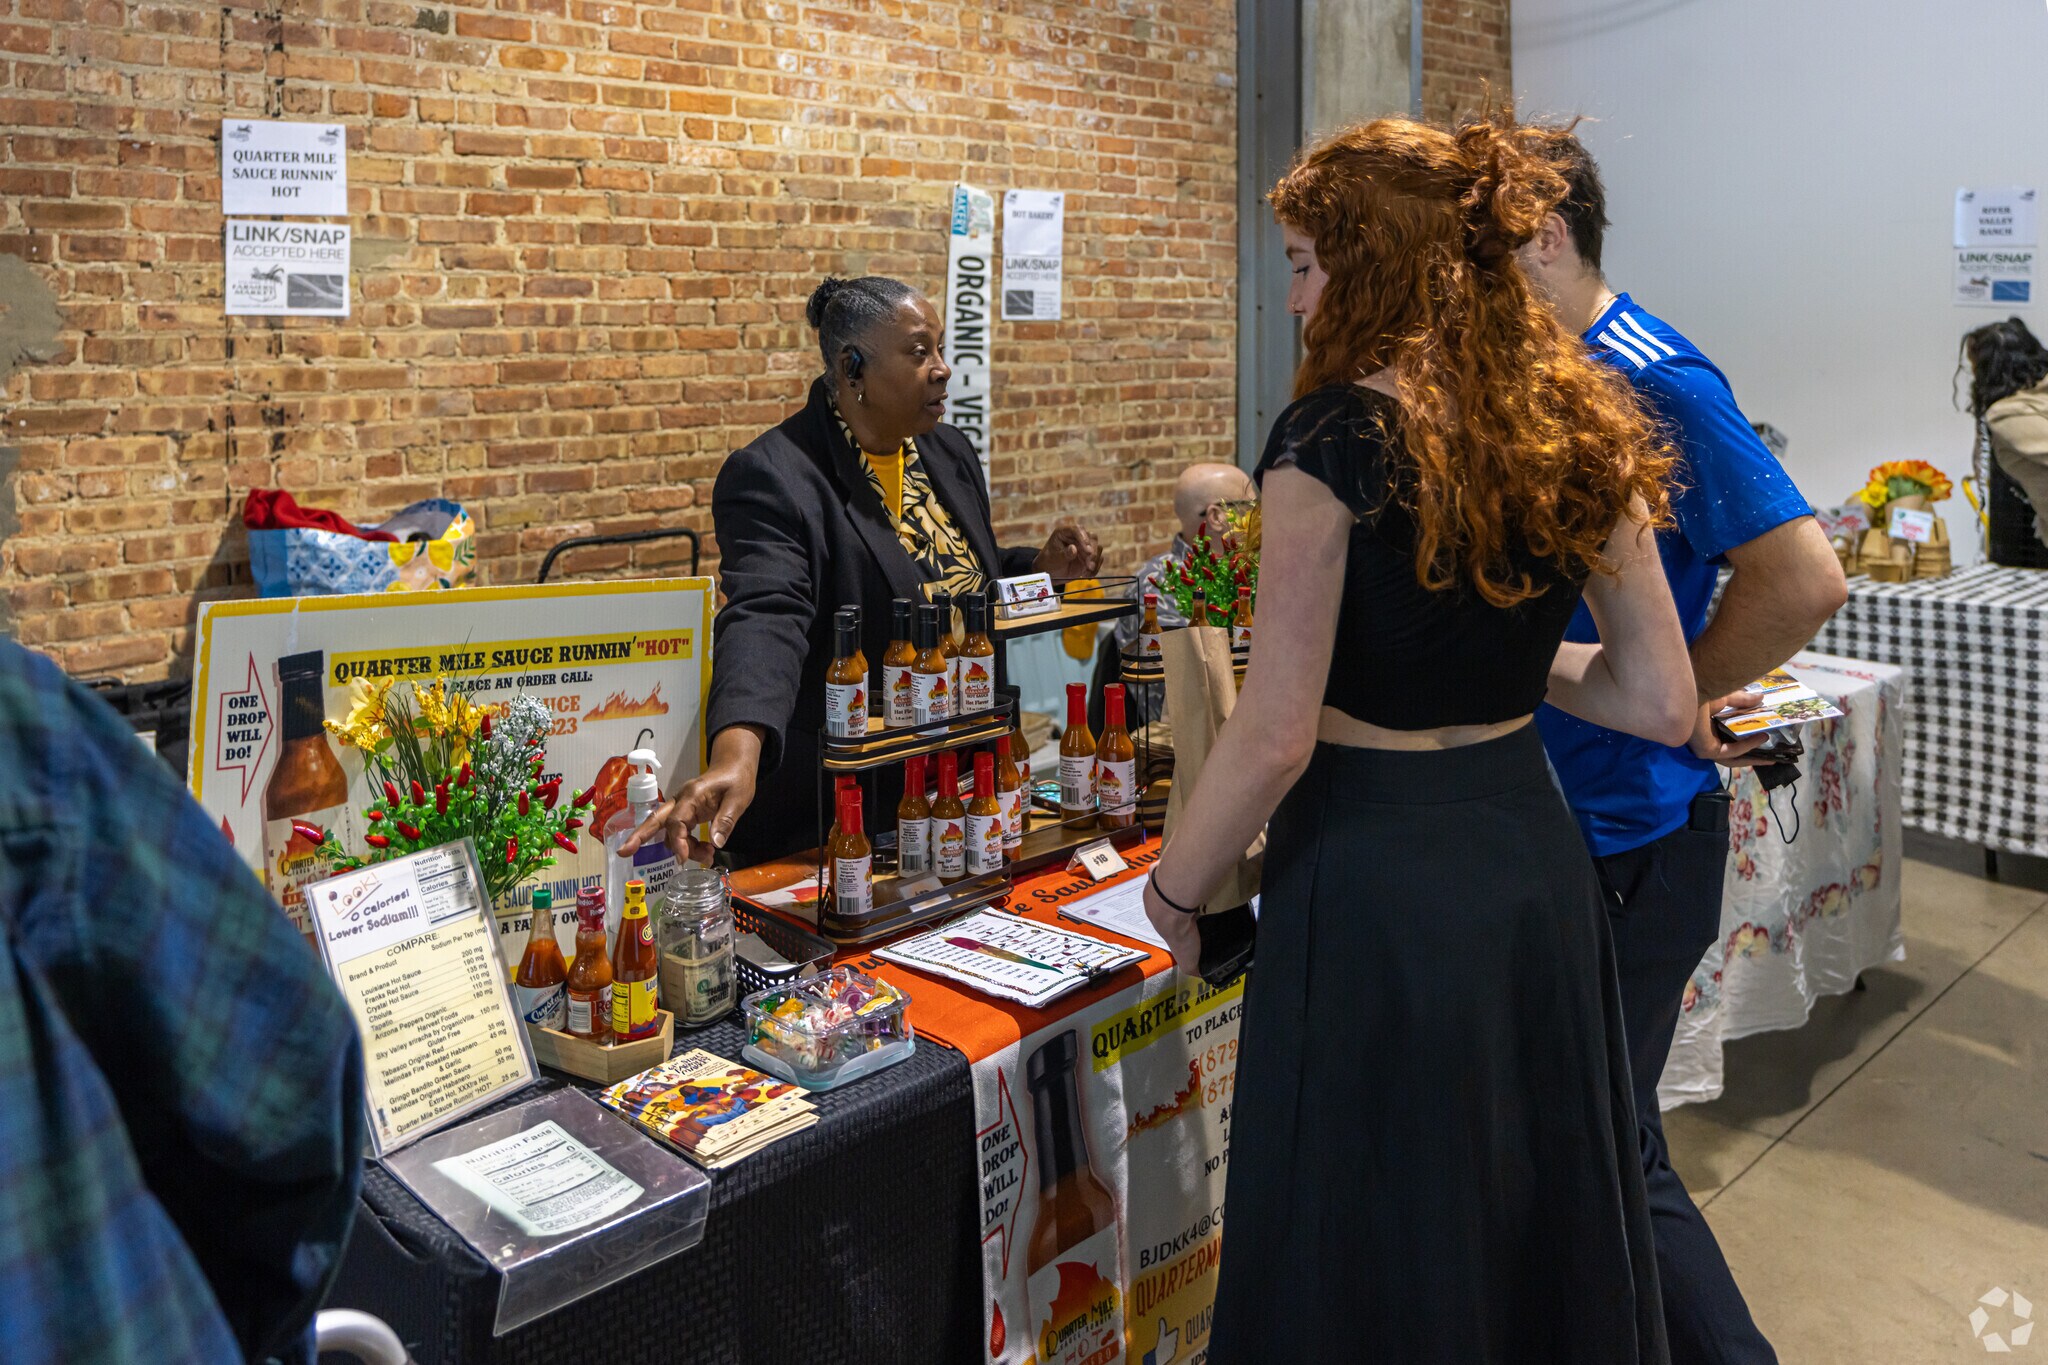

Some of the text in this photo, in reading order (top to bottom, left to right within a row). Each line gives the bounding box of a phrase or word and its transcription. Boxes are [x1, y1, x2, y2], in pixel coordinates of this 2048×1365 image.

[233, 150, 336, 164] QUARTER MILE
[232, 168, 338, 181] SAUCE RUNNIN'
[272, 186, 301, 198] HOT
[1028, 211, 1054, 220] BAKERY
[1982, 206, 2010, 214] RIVER
[1978, 217, 2012, 226] VALLEY
[233, 226, 346, 244] LINK/SNAP
[1979, 228, 2012, 236] RANCH
[233, 244, 344, 260] ACCEPTED HERE
[1959, 252, 2032, 264] LINK/SNAP
[1006, 258, 1060, 270] LINK/SNAP
[1959, 264, 2030, 273] ACCEPTED HERE
[1006, 272, 1058, 281] ACCEPTED HERE
[953, 255, 985, 366] ORGANIC
[952, 394, 984, 457] VEG
[335, 636, 690, 684] QUARTER MILE SAUCE RUNNIN' "HOT"
[455, 679, 491, 692] PLACE
[494, 677, 512, 690] AN
[516, 673, 556, 688] ORDER
[561, 671, 593, 684] CALL:
[228, 694, 258, 709] ONE
[227, 711, 267, 727] DROP
[226, 728, 262, 744] WILL
[226, 746, 252, 761] DO!
[414, 849, 460, 867] Nutrition Facts
[650, 868, 674, 884] HAND
[420, 880, 449, 893] Calories
[363, 888, 410, 916] Calories!
[328, 924, 363, 942] Lower
[501, 922, 510, 934] A
[386, 932, 440, 956] COMPARE:
[431, 940, 452, 951] Sodium
[464, 931, 474, 939] Tsp
[349, 970, 368, 982] Brand
[375, 959, 398, 972] Product
[361, 982, 390, 997] Louisiana
[391, 976, 401, 985] Hot
[402, 970, 422, 981] Sauce
[462, 949, 473, 958] 200
[365, 992, 386, 1006] Franks
[386, 987, 399, 996] Red
[400, 982, 410, 991] Hot
[476, 954, 484, 962] mg
[366, 1002, 388, 1014] Crystal
[389, 996, 399, 1006] Hot
[400, 989, 419, 1000] Sauce
[479, 962, 488, 970] mg
[473, 982, 483, 990] 110
[368, 1010, 392, 1023] Cholula
[470, 974, 480, 982] 110
[531, 989, 564, 1022] Crystal
[375, 1027, 398, 1040] Arizona
[399, 1016, 424, 1030] Peppers
[424, 1006, 448, 1020] Organic
[417, 1012, 458, 1032] Harvest Foods
[1092, 990, 1191, 1058] QUARTER
[376, 1050, 388, 1060] Sky
[389, 1043, 408, 1054] Valley
[408, 1032, 432, 1046] sriracha
[432, 1028, 440, 1036] by
[441, 1014, 474, 1031] OrganicVille
[480, 1006, 490, 1015] 150
[428, 1030, 460, 1048] Gluten Free
[1186, 1026, 1202, 1044] TO
[382, 1063, 407, 1077] Tabasco
[408, 1053, 431, 1066] Original
[432, 1046, 444, 1055] Red
[384, 1071, 412, 1087] Melindas
[413, 1066, 425, 1074] Fire
[426, 1054, 449, 1067] Roasted
[450, 1042, 478, 1057] Habanero
[445, 1058, 462, 1070] Garlic
[389, 1092, 410, 1105] Gringo
[411, 1081, 433, 1096] Bandito
[434, 1072, 452, 1084] Green
[453, 1064, 471, 1076] Sauce
[391, 1099, 418, 1114] Melindas
[420, 1087, 442, 1102] Original
[443, 1074, 471, 1090] Habanero
[429, 1074, 488, 1107] Extra XXXtra Hot
[397, 1118, 419, 1133] Quarter
[420, 1112, 433, 1122] Mile
[434, 1102, 453, 1115] Sauce
[510, 1070, 519, 1078] mg
[466, 1128, 552, 1165] Nutrition Facts
[982, 1123, 1011, 1154] ONE
[983, 1141, 1020, 1178] DROP
[492, 1162, 546, 1184] Calories
[984, 1168, 1019, 1202] WILL
[985, 1198, 1009, 1226] DO!
[1046, 1295, 1114, 1358] QUARTER MILE
